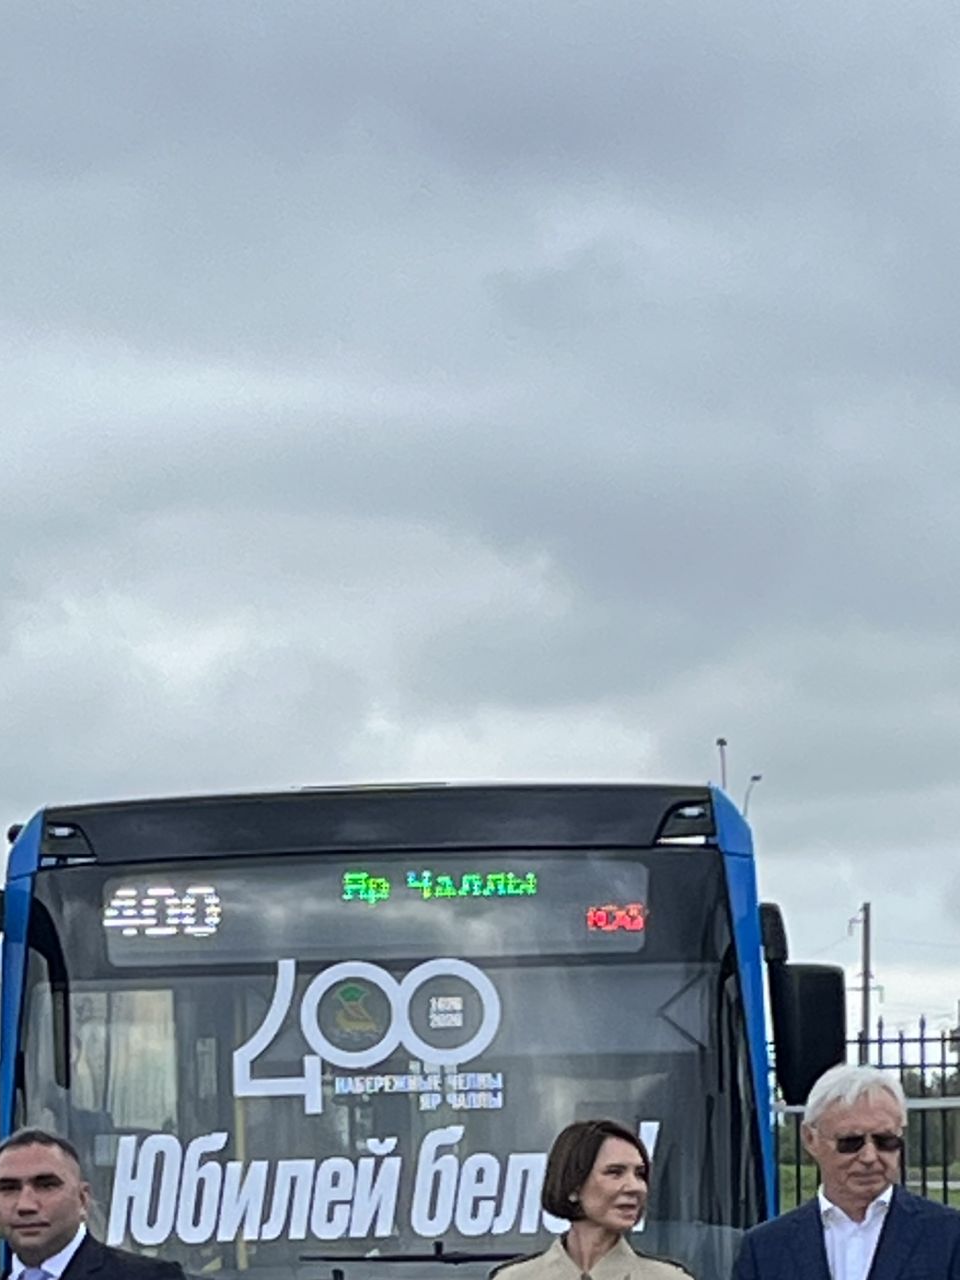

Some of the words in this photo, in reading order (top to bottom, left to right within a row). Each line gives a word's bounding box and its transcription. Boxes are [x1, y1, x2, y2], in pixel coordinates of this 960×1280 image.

[103, 886, 222, 937] 400
[406, 870, 538, 898] Чаллы
[233, 957, 501, 1115] 400
[106, 1131, 404, 1246] Юбилей
